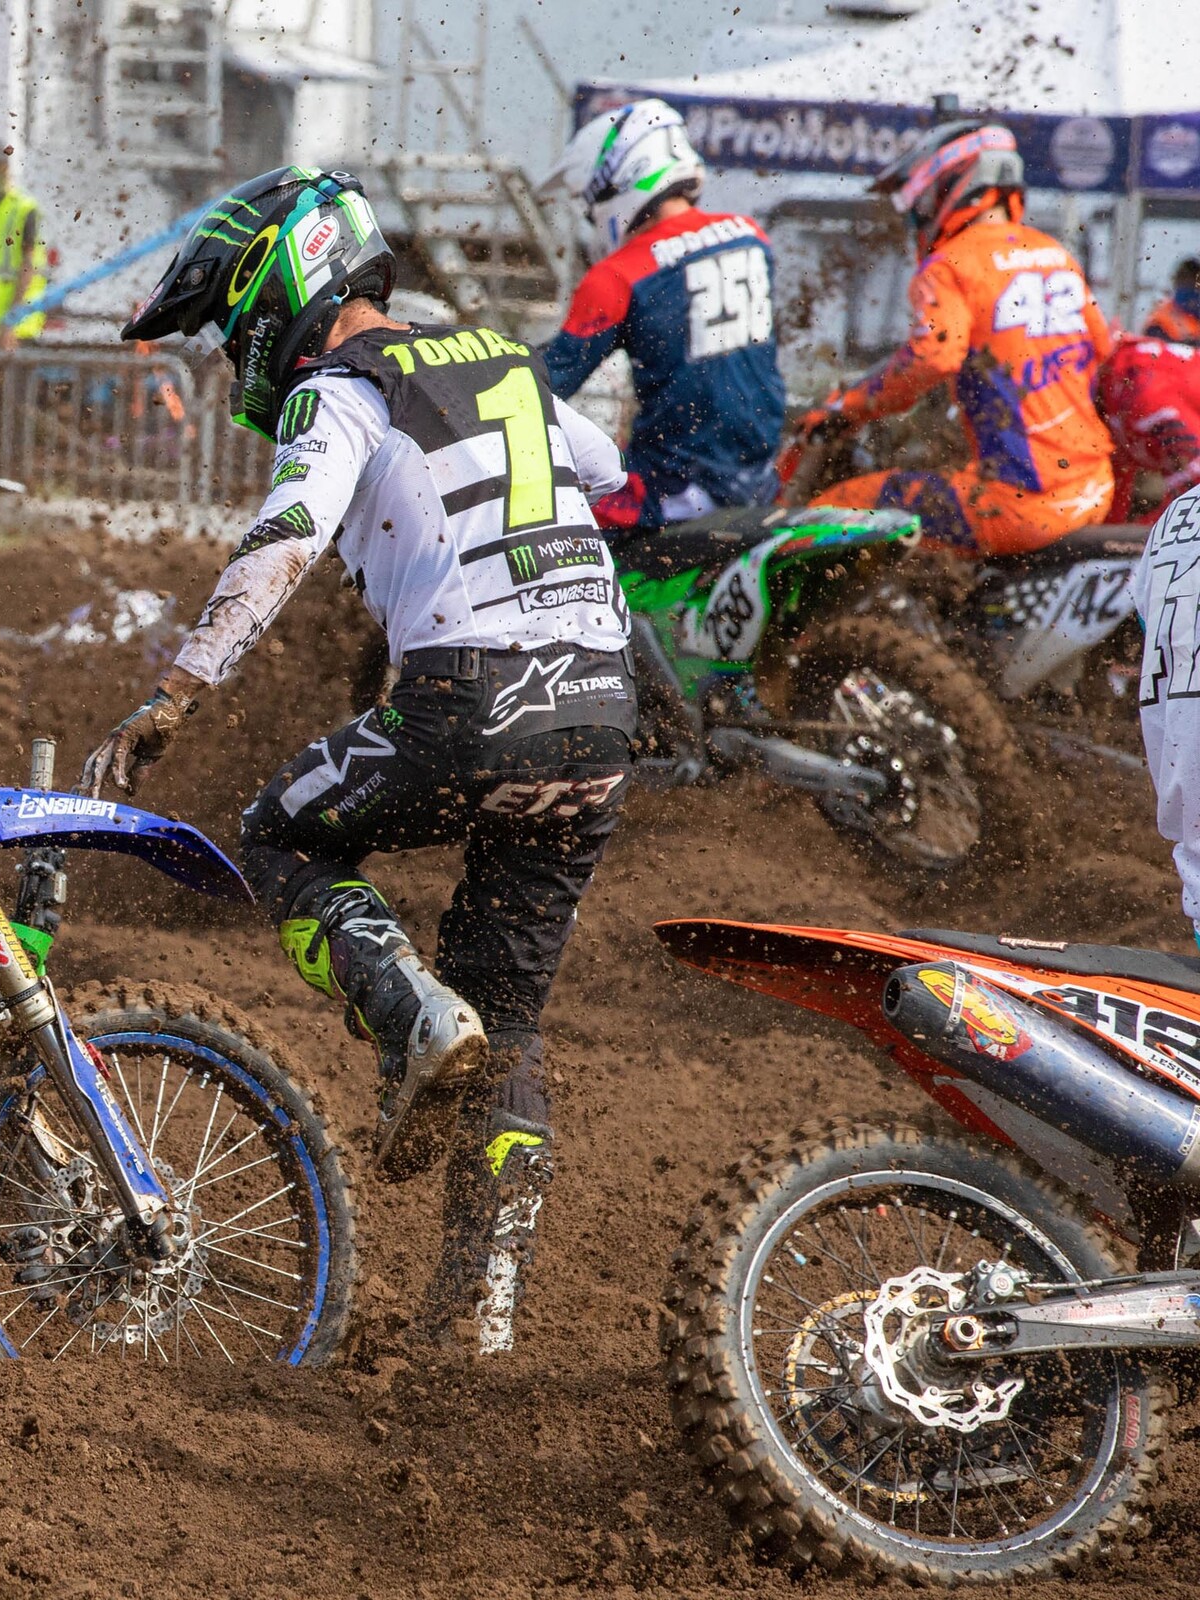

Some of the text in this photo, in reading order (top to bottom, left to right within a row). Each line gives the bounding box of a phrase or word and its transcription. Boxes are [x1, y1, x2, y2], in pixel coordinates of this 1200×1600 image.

[305, 224, 334, 256] BELL
[993, 272, 1087, 338] 42
[244, 316, 271, 392] MONSTER
[476, 367, 553, 528] 1
[557, 676, 623, 696] ASTARS
[1122, 1394, 1140, 1449] KENDA
